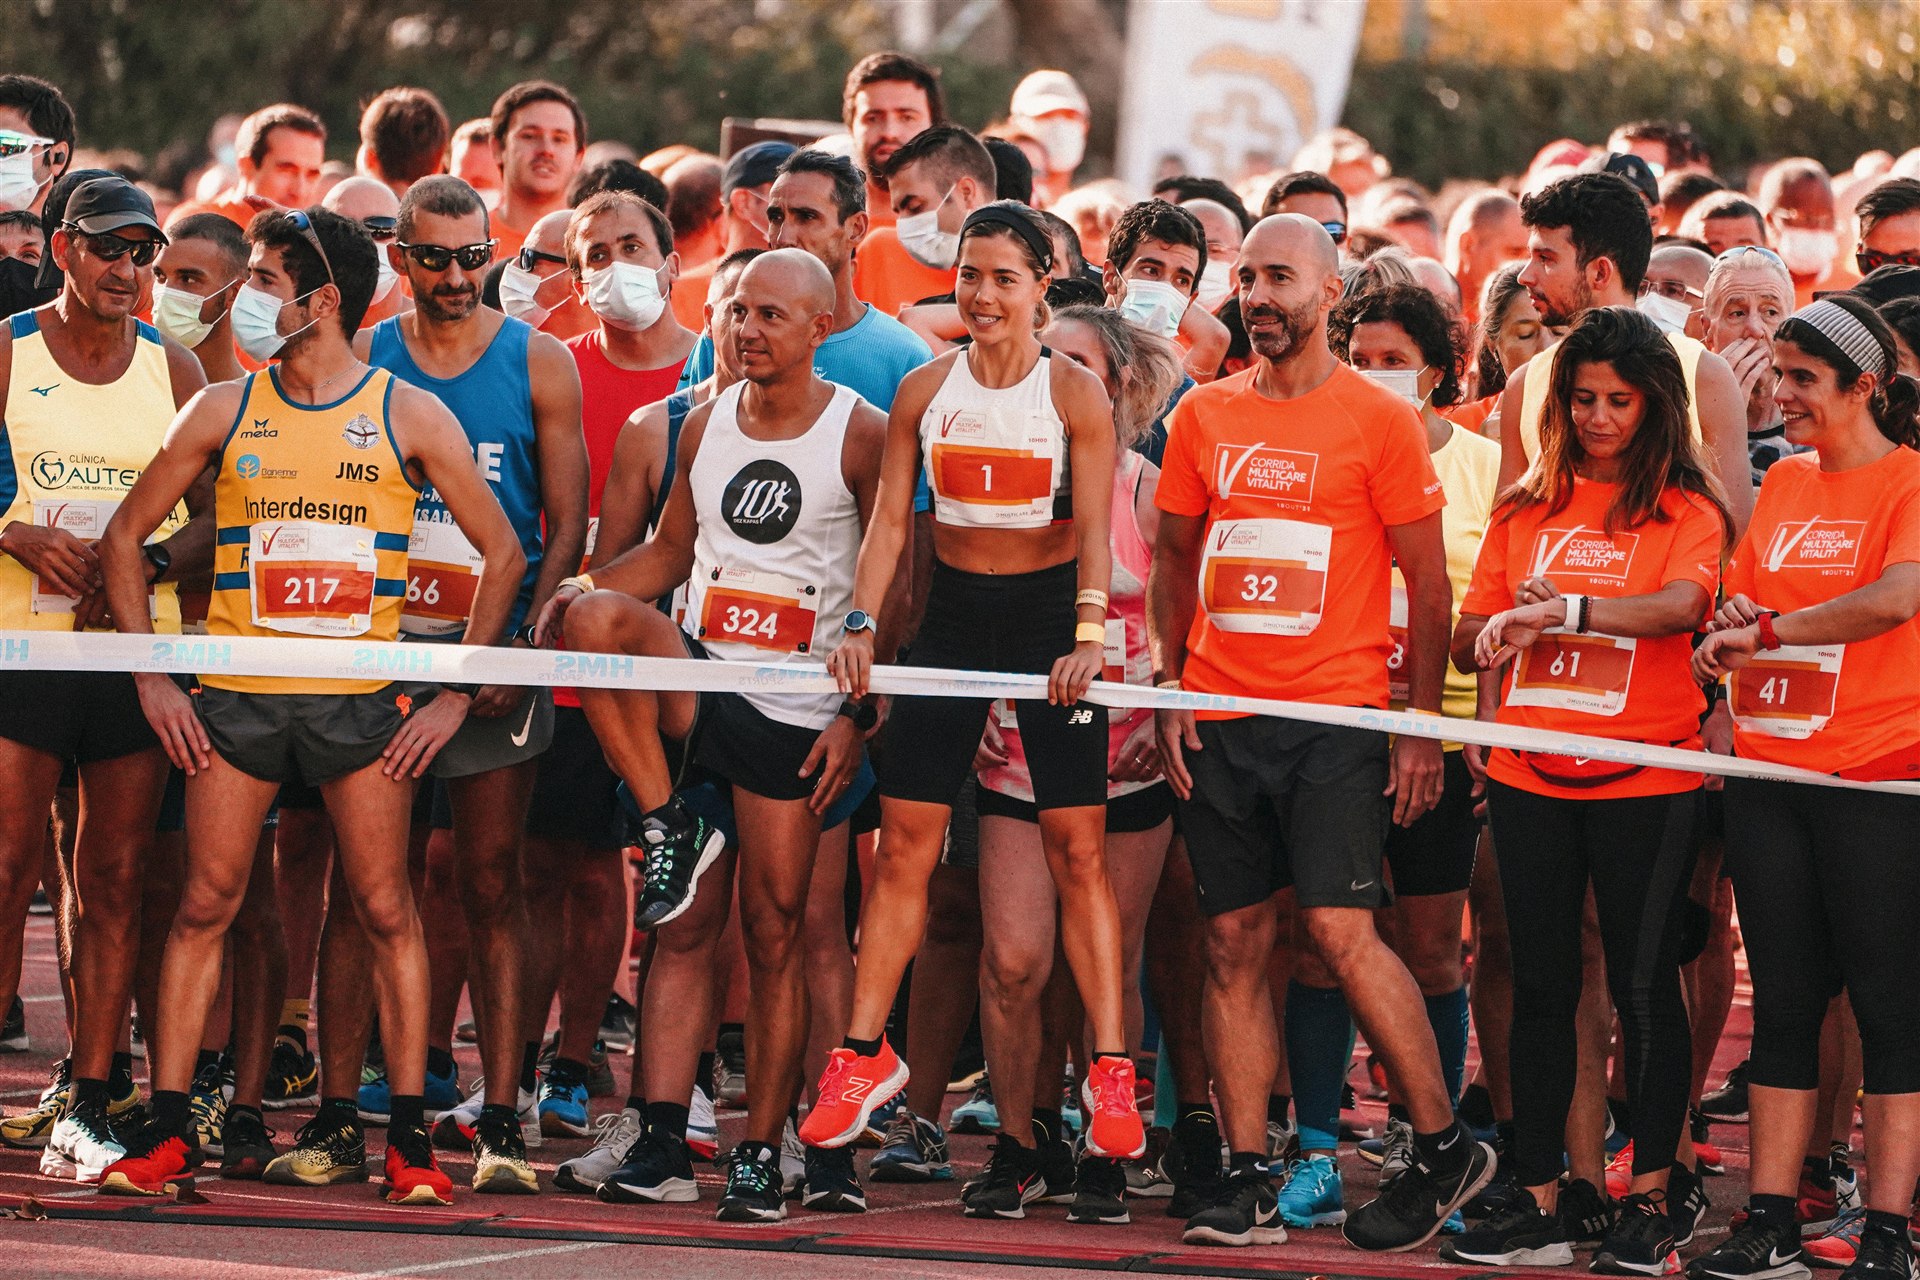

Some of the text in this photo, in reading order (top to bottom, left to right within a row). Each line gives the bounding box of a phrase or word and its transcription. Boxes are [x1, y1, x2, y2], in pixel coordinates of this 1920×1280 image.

[240, 430, 278, 438] meta
[69, 453, 106, 464] CLÍNICA
[1250, 457, 1295, 470] CORRIDA
[335, 462, 380, 482] JMS
[981, 464, 992, 492] 1
[1248, 467, 1307, 482] MULTICARE
[1246, 477, 1293, 491] VITALITY
[244, 495, 367, 526] Interdesign
[1806, 530, 1845, 540] CORRIDA
[1569, 538, 1615, 550] CORRIDA
[1802, 539, 1855, 549] MULTICARE
[1566, 549, 1626, 560] MULTICARE
[1800, 549, 1841, 558] VITALITY
[1564, 558, 1612, 568] VITALITY
[284, 577, 340, 604] 217
[1241, 574, 1278, 602] 32
[722, 605, 778, 640] 324
[1549, 650, 1581, 678] 61
[1759, 677, 1789, 705] 41
[1571, 699, 1600, 707] MULTICARE
